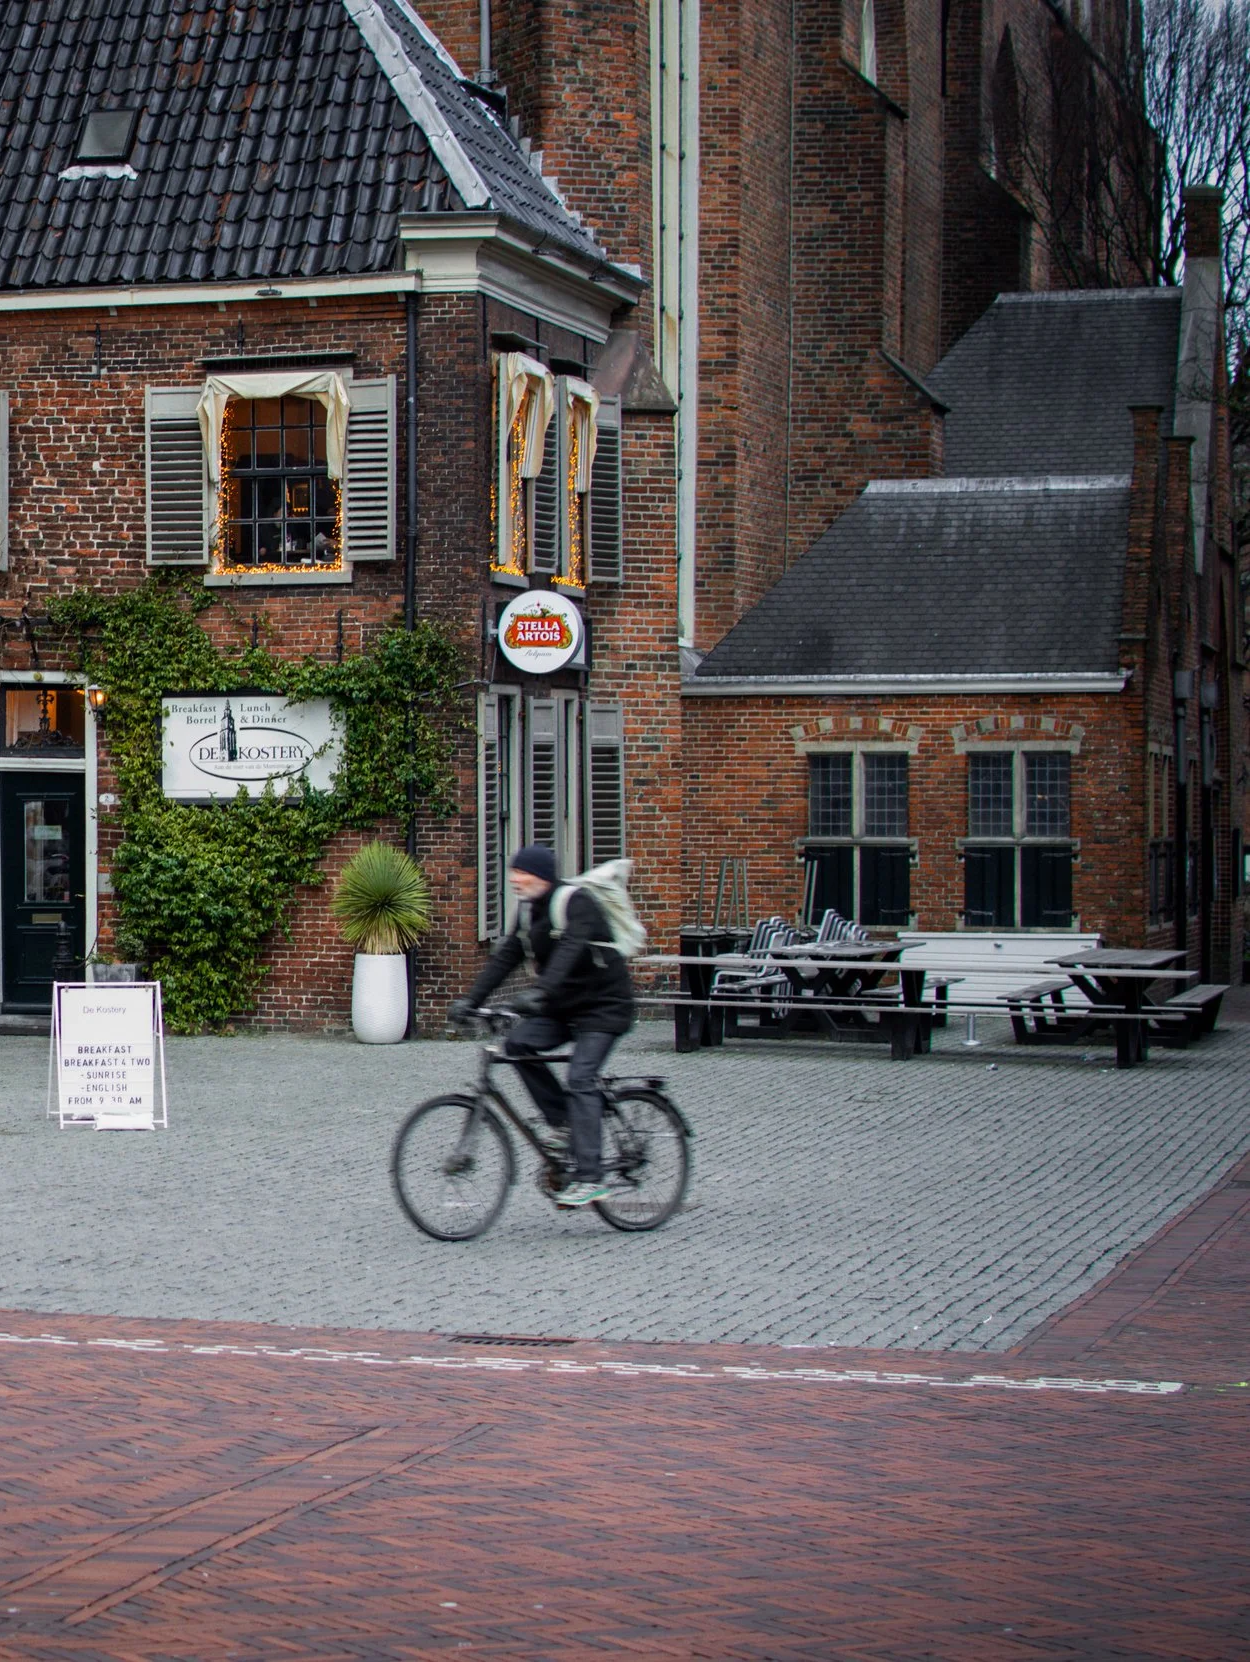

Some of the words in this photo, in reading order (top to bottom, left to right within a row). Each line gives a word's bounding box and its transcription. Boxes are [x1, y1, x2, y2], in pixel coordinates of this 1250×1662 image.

[517, 621, 560, 631] STELLA
[516, 631, 561, 641] ARTOIS
[171, 703, 217, 713] Breakfast
[240, 703, 271, 712] Lunch
[186, 715, 217, 725] Borrel
[240, 716, 249, 724] &
[252, 714, 287, 724] Dinner
[199, 747, 219, 760] DE
[238, 745, 307, 760] KOSTERY
[83, 1006, 94, 1014] De
[96, 1006, 126, 1015] Kostery
[77, 1046, 132, 1055] BREAKFAST
[64, 1058, 118, 1067] BREAKFAST
[131, 1058, 150, 1066] TWO
[68, 1096, 93, 1105] FROM
[129, 1096, 142, 1105] AM
